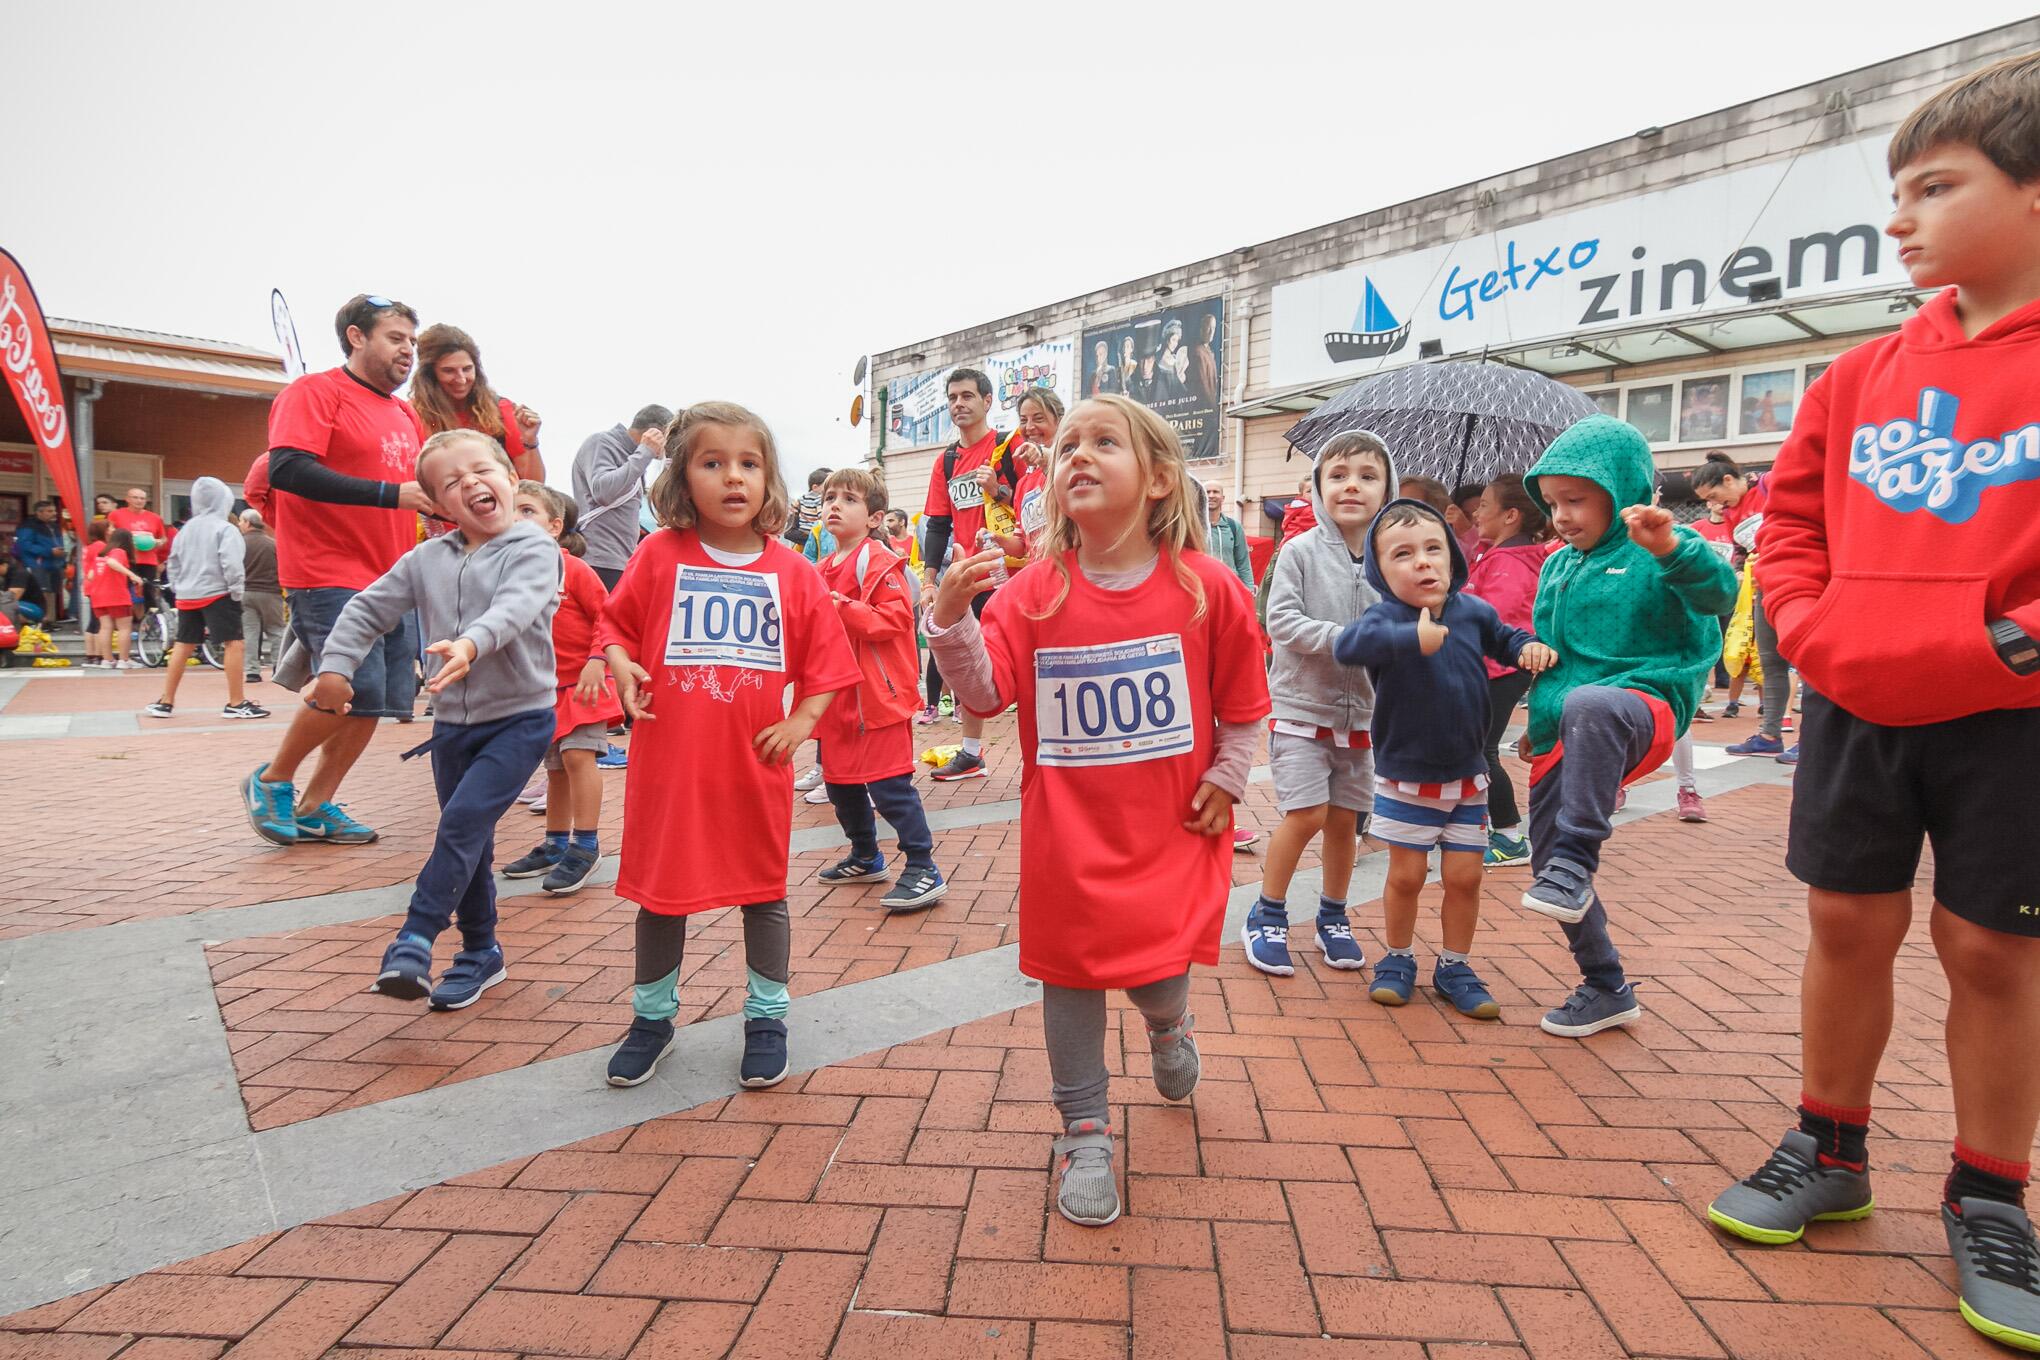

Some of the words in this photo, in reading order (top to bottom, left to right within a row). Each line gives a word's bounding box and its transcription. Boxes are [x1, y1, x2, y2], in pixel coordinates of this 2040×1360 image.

[1439, 239, 1600, 321] Getxo
[1578, 223, 1880, 326] zinem
[1169, 418, 1204, 432] PARIS
[1178, 395, 1197, 405] JULIO
[1849, 389, 1951, 484] Go!
[679, 595, 780, 647] 1008
[1054, 671, 1175, 737] 1008
